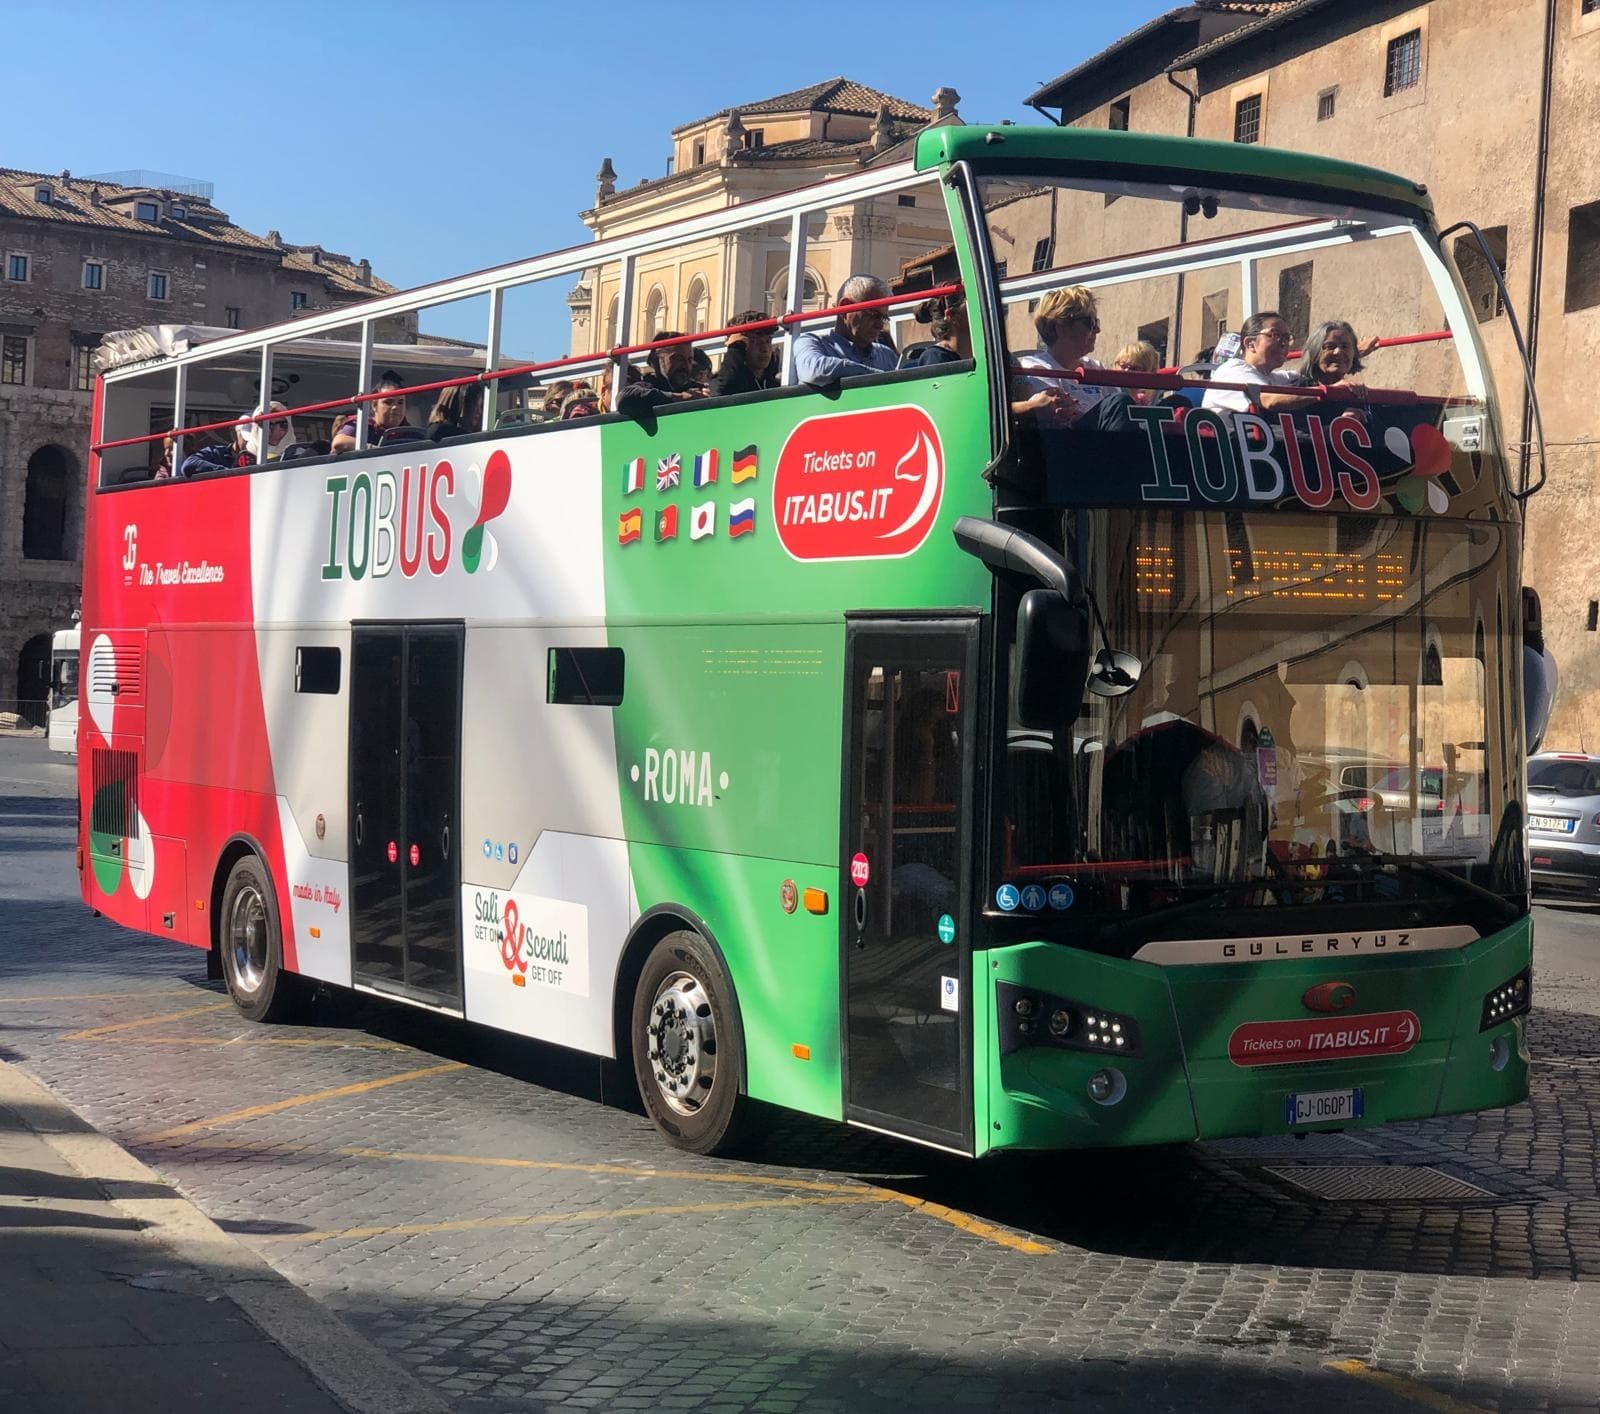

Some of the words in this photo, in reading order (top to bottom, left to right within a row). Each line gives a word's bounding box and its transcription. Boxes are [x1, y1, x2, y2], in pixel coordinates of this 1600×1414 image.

[803, 450, 853, 474] Tickets
[856, 450, 876, 468] on
[1127, 405, 1381, 510] IOBUS
[321, 458, 455, 582] IOBUS
[782, 488, 894, 526] ITABUS.IT
[139, 563, 153, 585] The
[155, 562, 181, 584] Travel
[182, 560, 224, 584] Excellence
[644, 747, 713, 807] ROMA
[851, 861, 869, 879] 203
[293, 882, 313, 901] made
[314, 883, 322, 902] in
[323, 884, 341, 914] Italy
[475, 891, 499, 925] Sali
[502, 899, 528, 974] &
[526, 926, 569, 965] Scendi
[475, 924, 488, 941] GET
[532, 965, 548, 983] GET
[548, 969, 563, 986] OFF
[1243, 1038, 1283, 1051] Tickets
[1286, 1038, 1301, 1049] on
[1308, 1027, 1390, 1050] ITABUS.IT
